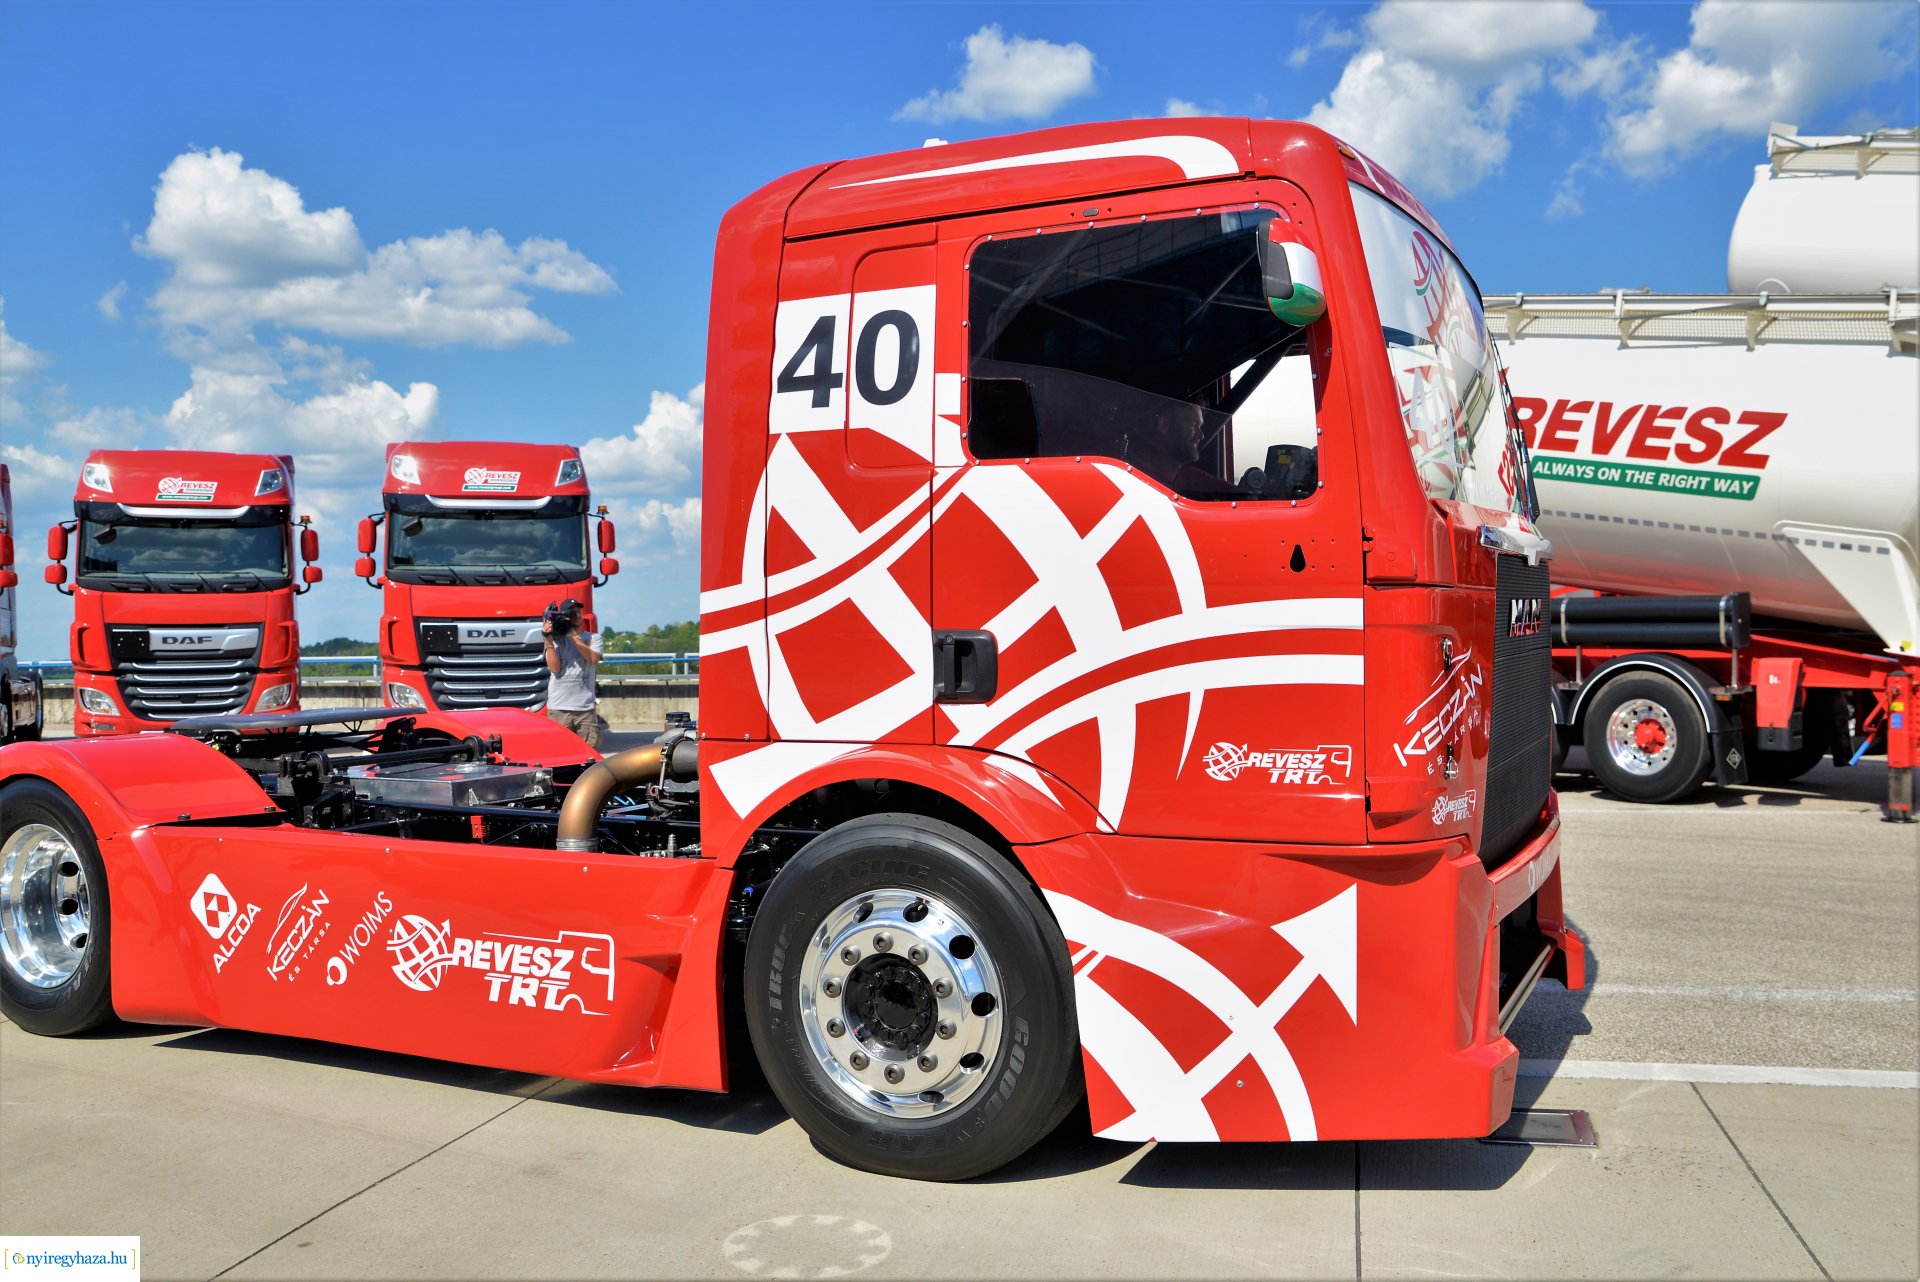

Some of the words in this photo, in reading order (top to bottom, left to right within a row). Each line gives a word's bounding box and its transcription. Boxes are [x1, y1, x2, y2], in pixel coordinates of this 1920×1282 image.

[777, 309, 920, 408] 40
[1533, 461, 1595, 479] ALWAYS
[1597, 467, 1621, 481] ON
[1624, 470, 1656, 485] THE
[1658, 472, 1710, 490] RIGHT
[1713, 478, 1754, 494] WAY
[162, 636, 213, 645] DAF
[467, 629, 515, 638] DAF
[1268, 768, 1323, 784] TRT
[213, 903, 262, 974] ALCOA
[339, 891, 393, 965] WOIMS
[484, 973, 570, 1011] TRT
